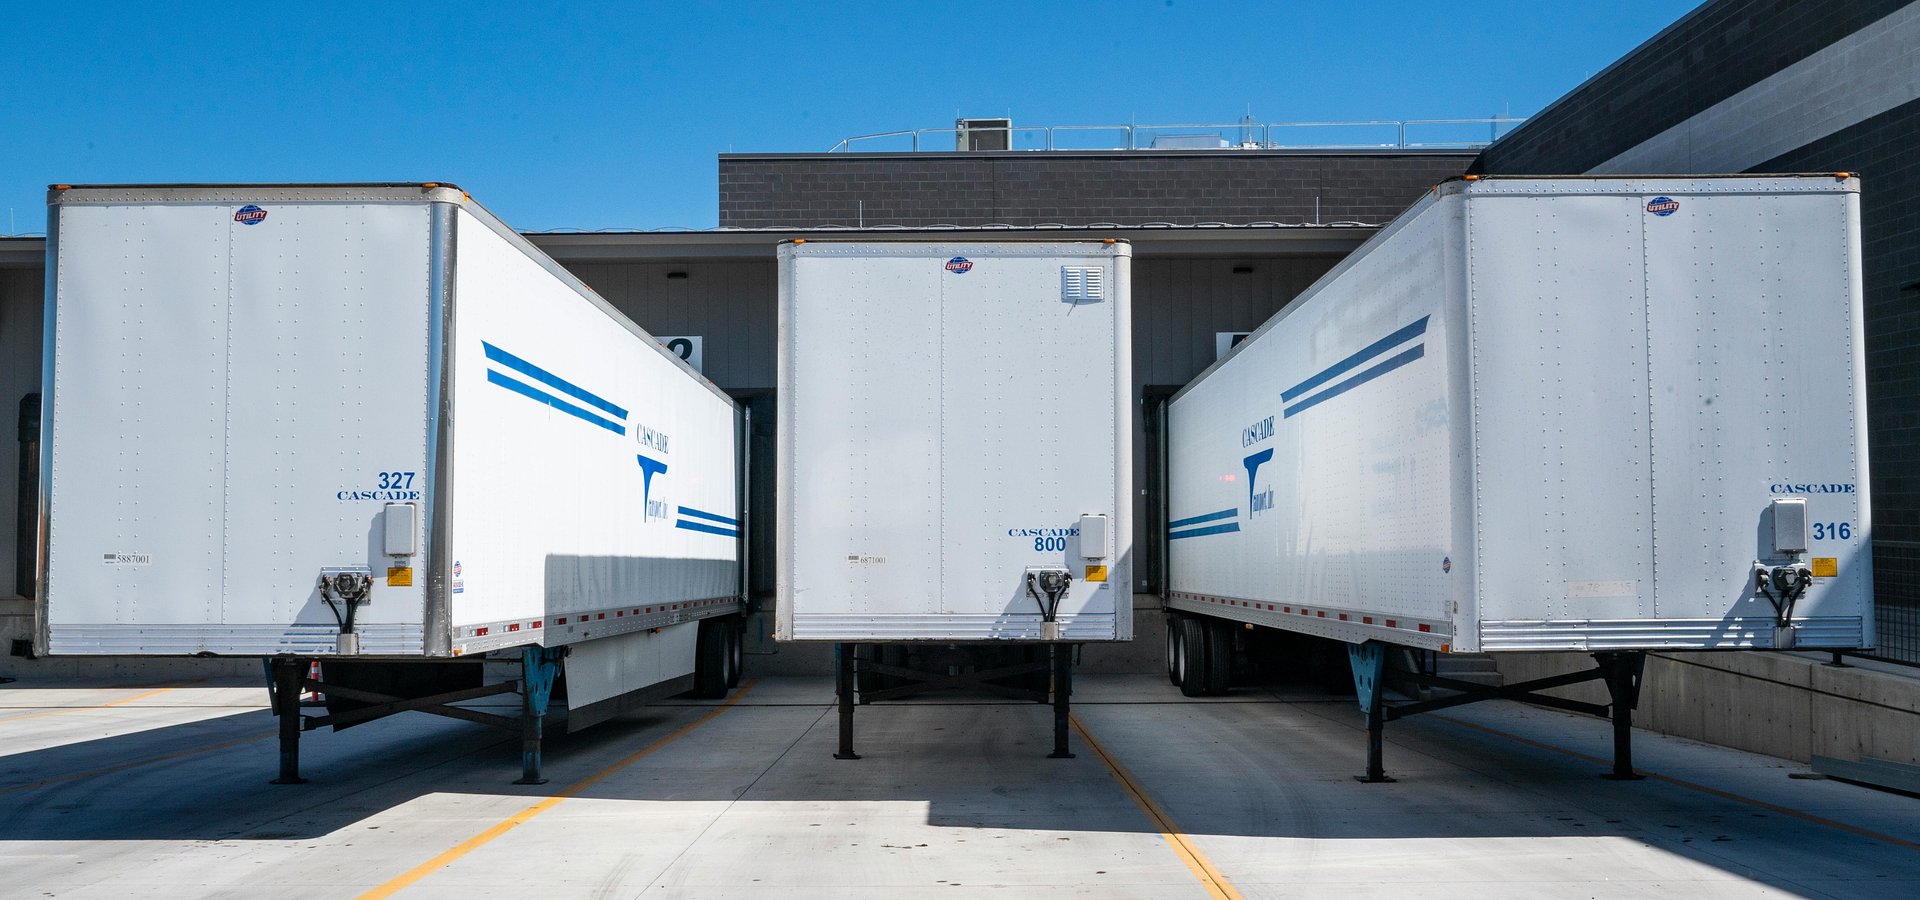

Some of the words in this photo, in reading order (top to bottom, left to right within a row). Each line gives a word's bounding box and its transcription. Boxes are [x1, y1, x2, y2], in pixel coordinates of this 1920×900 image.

[1648, 203, 1678, 212] UTILITY
[236, 211, 266, 221] UTILITY
[946, 262, 972, 270] UTILITY
[1242, 415, 1275, 449] CASCADE
[636, 422, 669, 455] CASCADE
[378, 471, 416, 490] 327
[1770, 483, 1856, 494] CASCADE
[336, 490, 420, 501] CASCADE
[1008, 527, 1080, 537] CASCADE
[1812, 522, 1851, 540] 316
[1034, 536, 1066, 552] 800
[116, 554, 149, 564] 5887001
